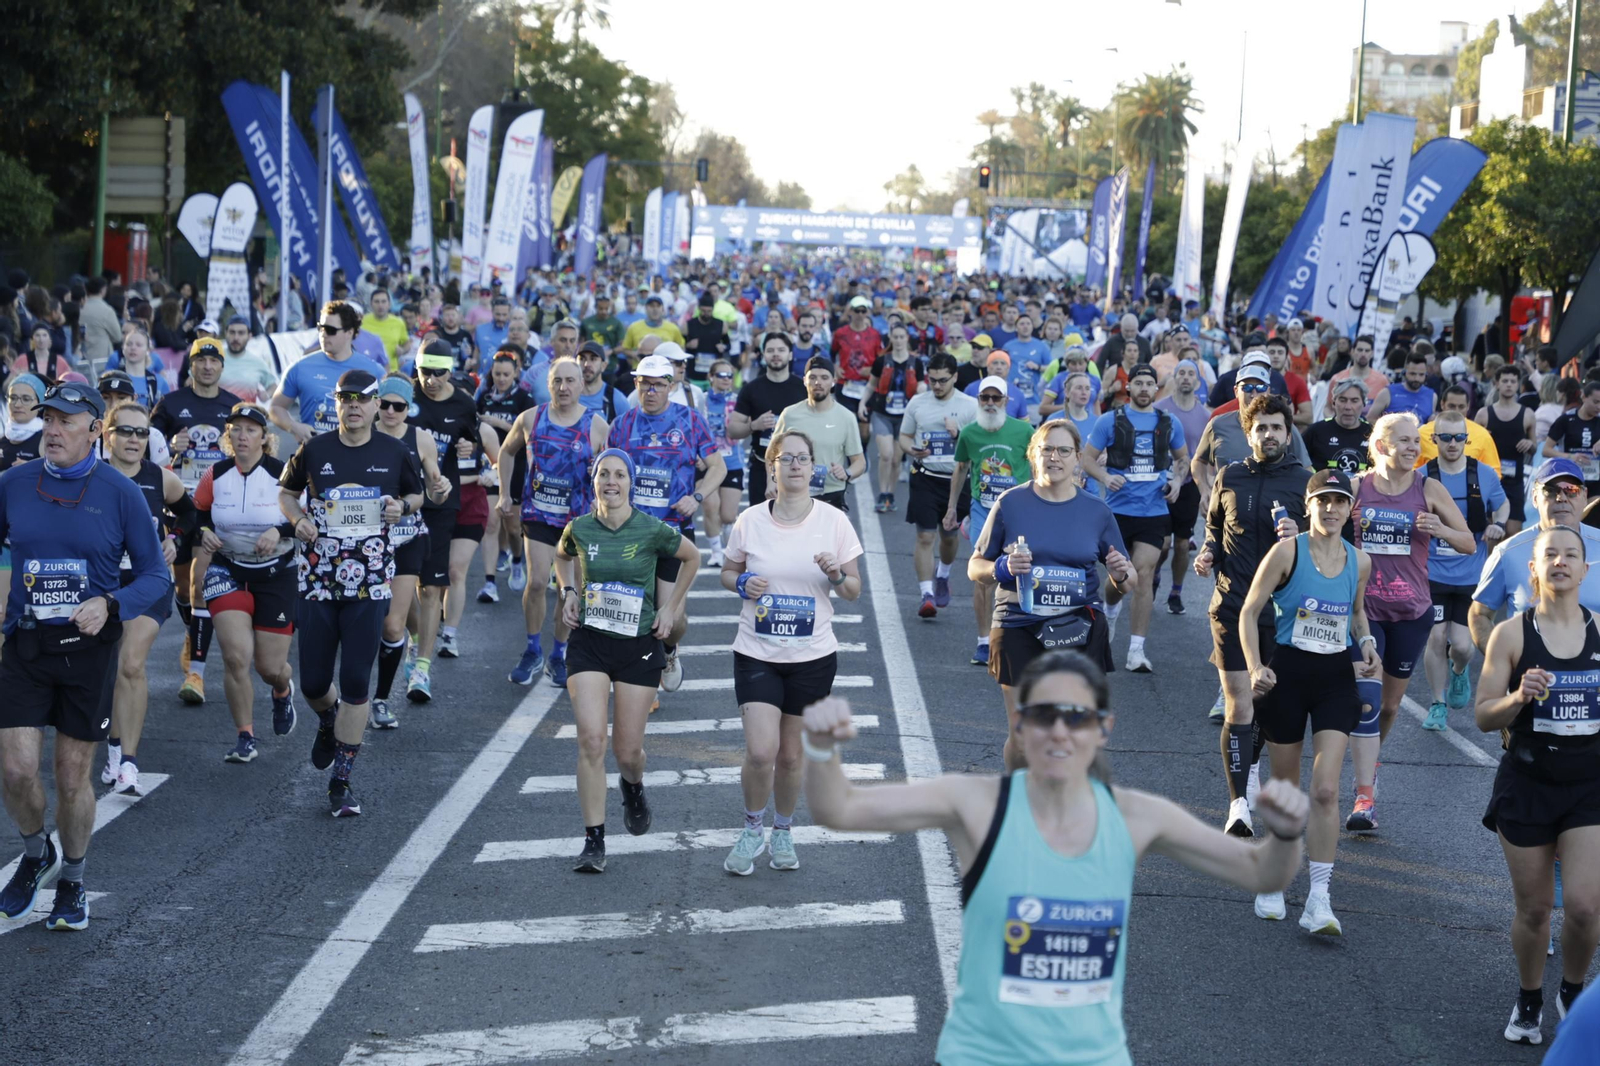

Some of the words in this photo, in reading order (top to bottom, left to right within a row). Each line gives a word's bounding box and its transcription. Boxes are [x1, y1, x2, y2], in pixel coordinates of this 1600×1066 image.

[759, 212, 800, 226] ZURICH
[855, 217, 870, 229] DE
[871, 217, 916, 231] SEVILLA
[1348, 156, 1395, 311] CaixaBank
[197, 450, 221, 459] ZURICH
[642, 467, 667, 476] ZURICH
[1129, 465, 1155, 473] TOMMY
[545, 476, 569, 486] ZURICH
[343, 490, 374, 498] ZURICH
[534, 491, 567, 506] GIGANTE
[340, 514, 366, 525] JOSE
[1378, 511, 1408, 520] ZURICH
[1376, 524, 1395, 532] 14304
[1362, 532, 1394, 543] CAMPO
[1396, 535, 1410, 544] DE
[44, 562, 80, 571] ZURICH
[1048, 569, 1079, 578] ZURICH
[43, 579, 68, 589] 13723
[202, 581, 232, 598] ABRINA
[605, 583, 637, 595] ZURICH
[1046, 584, 1067, 592] 13911
[32, 590, 80, 604] PIGSICK
[604, 597, 622, 607] 12201
[777, 598, 809, 607] ZURICH
[1041, 594, 1071, 606] CLEM
[586, 607, 639, 624] COQUILETTE
[774, 613, 797, 621] 13907
[1316, 617, 1338, 628] 12348
[771, 623, 798, 635] LOLY
[1302, 625, 1341, 643] MICHAL
[1560, 674, 1599, 684] ZURICH
[1558, 693, 1585, 703] 13984
[1552, 705, 1590, 719] LUCIE
[1049, 903, 1114, 922] ZURICH
[1044, 934, 1090, 954] 14119
[1020, 953, 1103, 981] ESTHER
